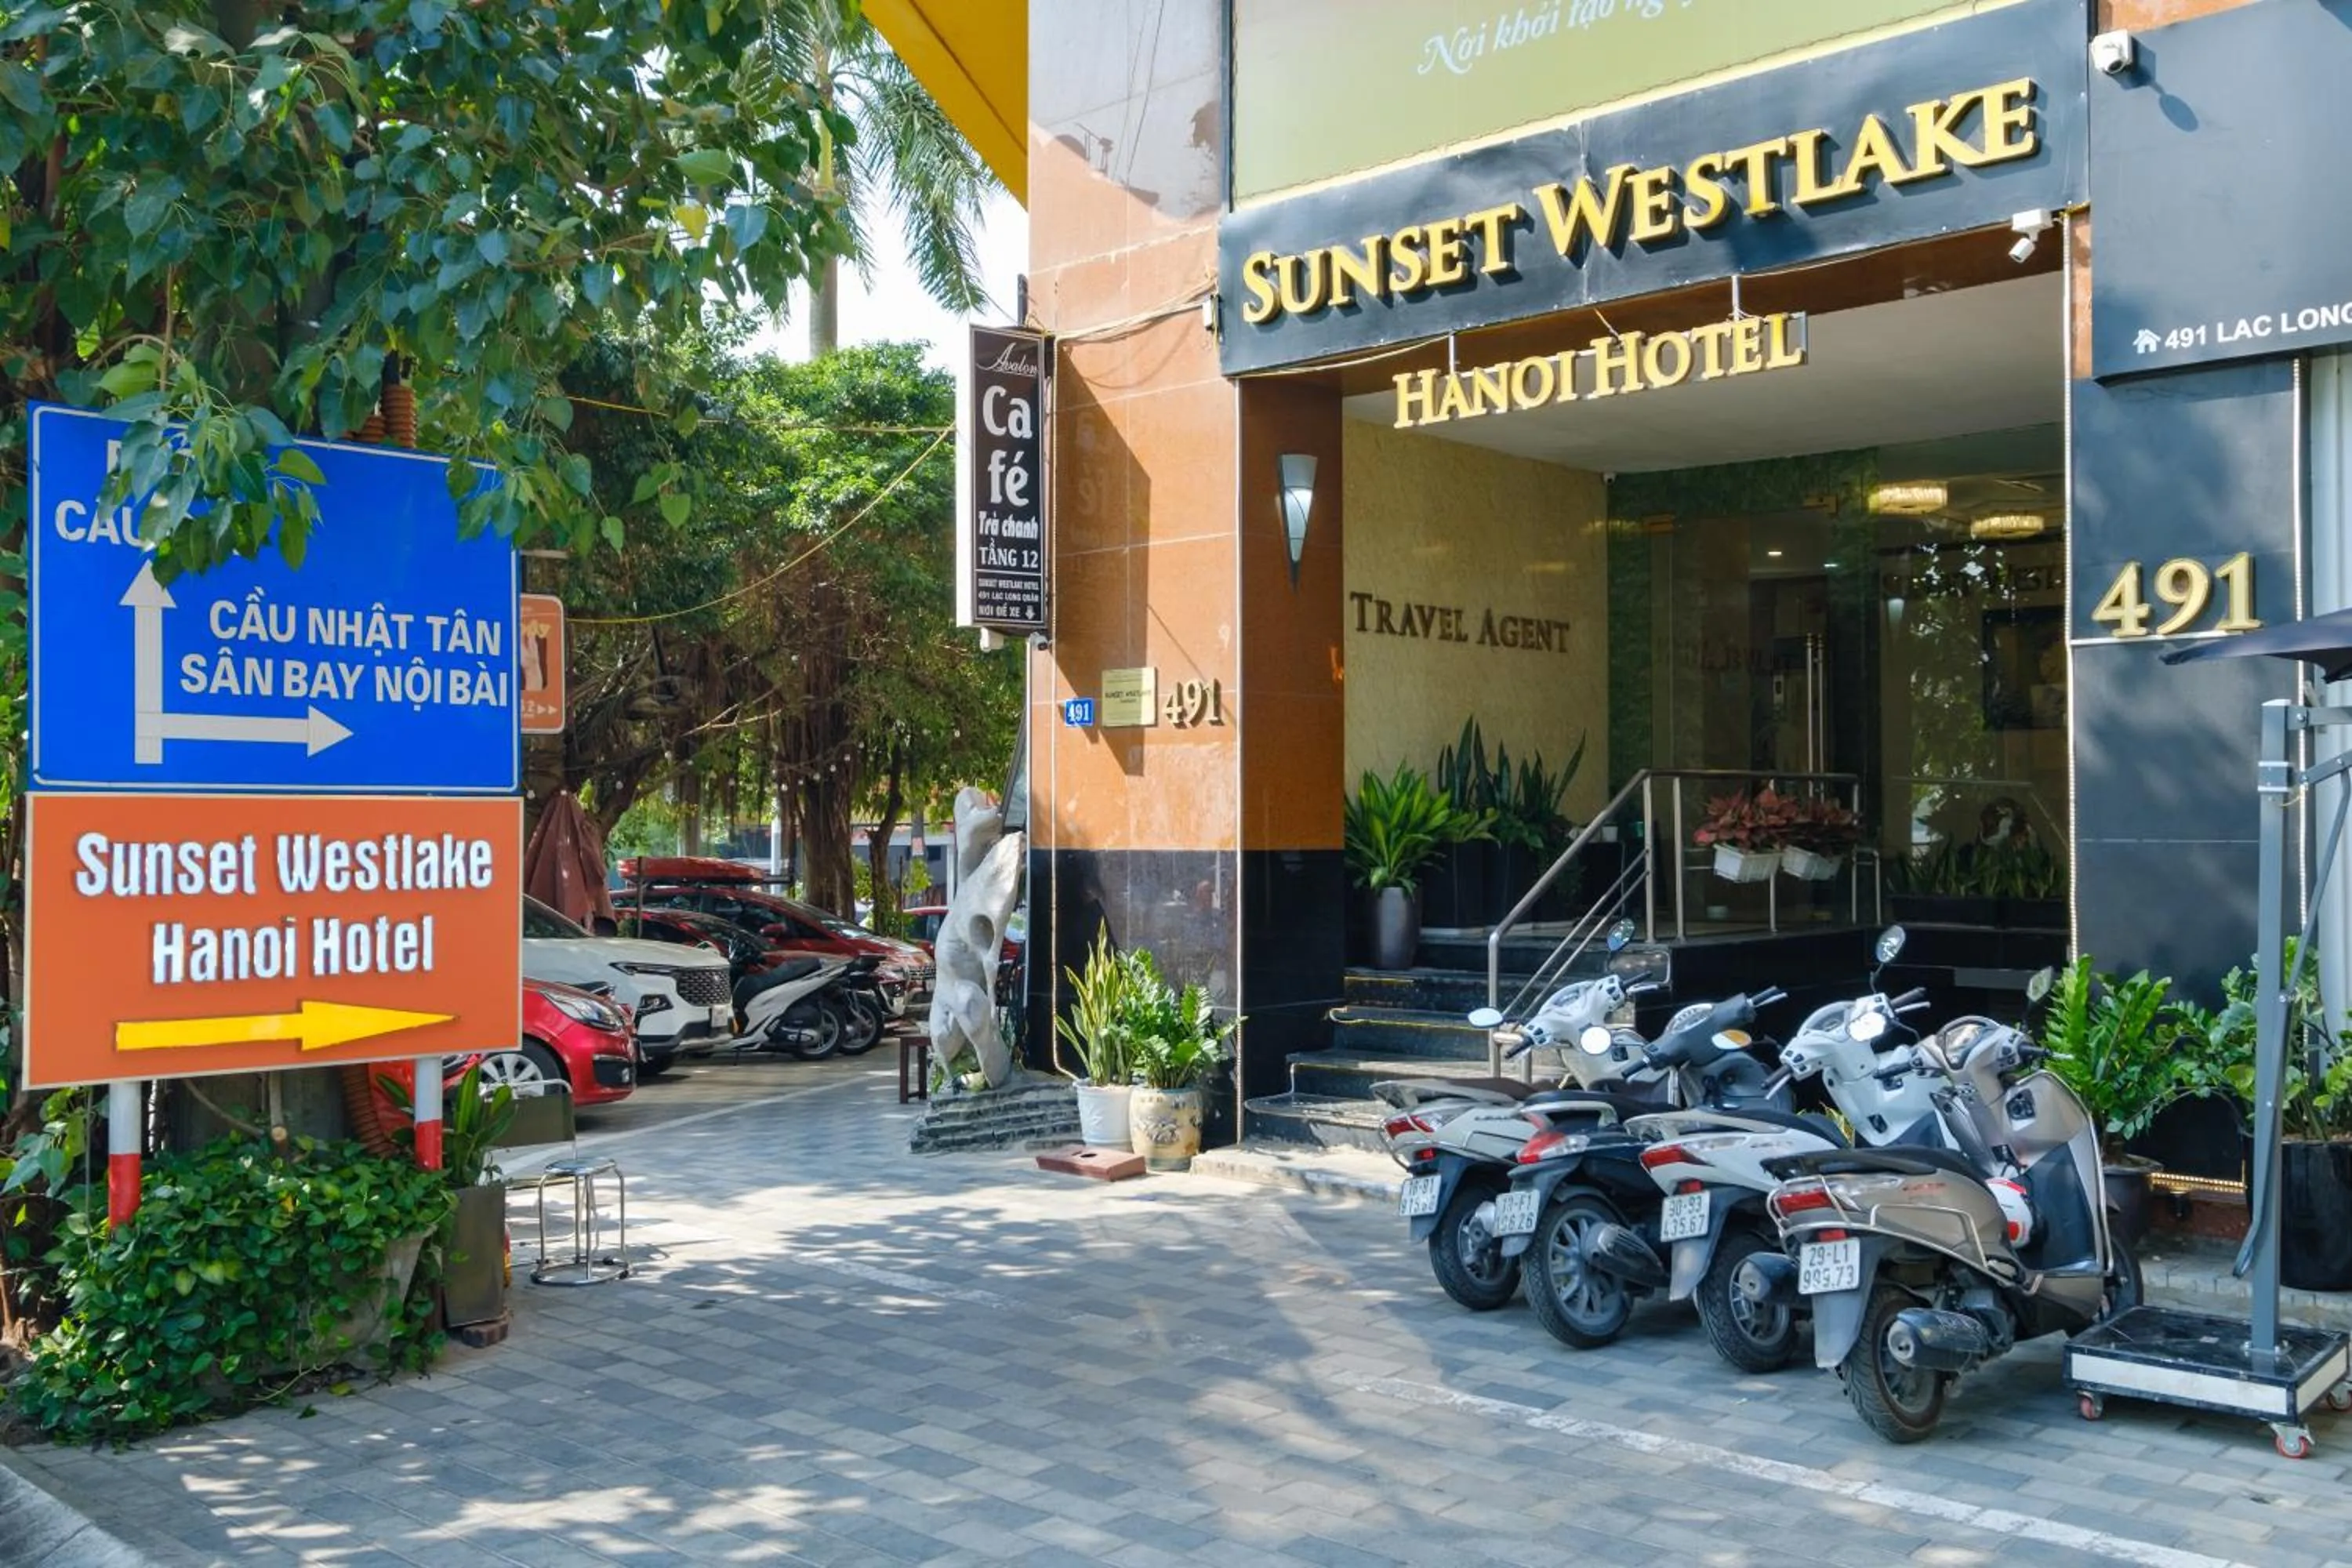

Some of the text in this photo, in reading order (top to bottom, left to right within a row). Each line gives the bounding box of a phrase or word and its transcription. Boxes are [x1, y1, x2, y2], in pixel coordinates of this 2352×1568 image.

[1417, 23, 1486, 74] Nơi
[1493, 0, 1560, 53] khởi
[1242, 77, 2040, 325] SUNSET WESTLAKE
[975, 343, 1038, 375] Avalon
[2165, 325, 2206, 349] 491
[2217, 315, 2272, 343] LAC
[1392, 314, 1804, 429] HANOI HOTEL
[982, 385, 1033, 439] Ca
[988, 449, 1029, 507] fé
[978, 510, 1038, 539] Trà chanh
[978, 537, 1038, 568] TẦNG 12
[209, 586, 501, 657] CẦU NHẬT TÂN
[1010, 606, 1021, 617] XE
[1350, 591, 1570, 654] TRAVEL AGENT
[2091, 552, 2263, 638] 491
[180, 647, 507, 711] SÂN BAY NỘI BÀI
[1162, 677, 1220, 728] 491
[1067, 703, 1090, 721] 491
[75, 832, 493, 898] Sunset Westlake
[152, 914, 434, 985] Hanoi Hotel
[1809, 1243, 1849, 1267] 29-L1
